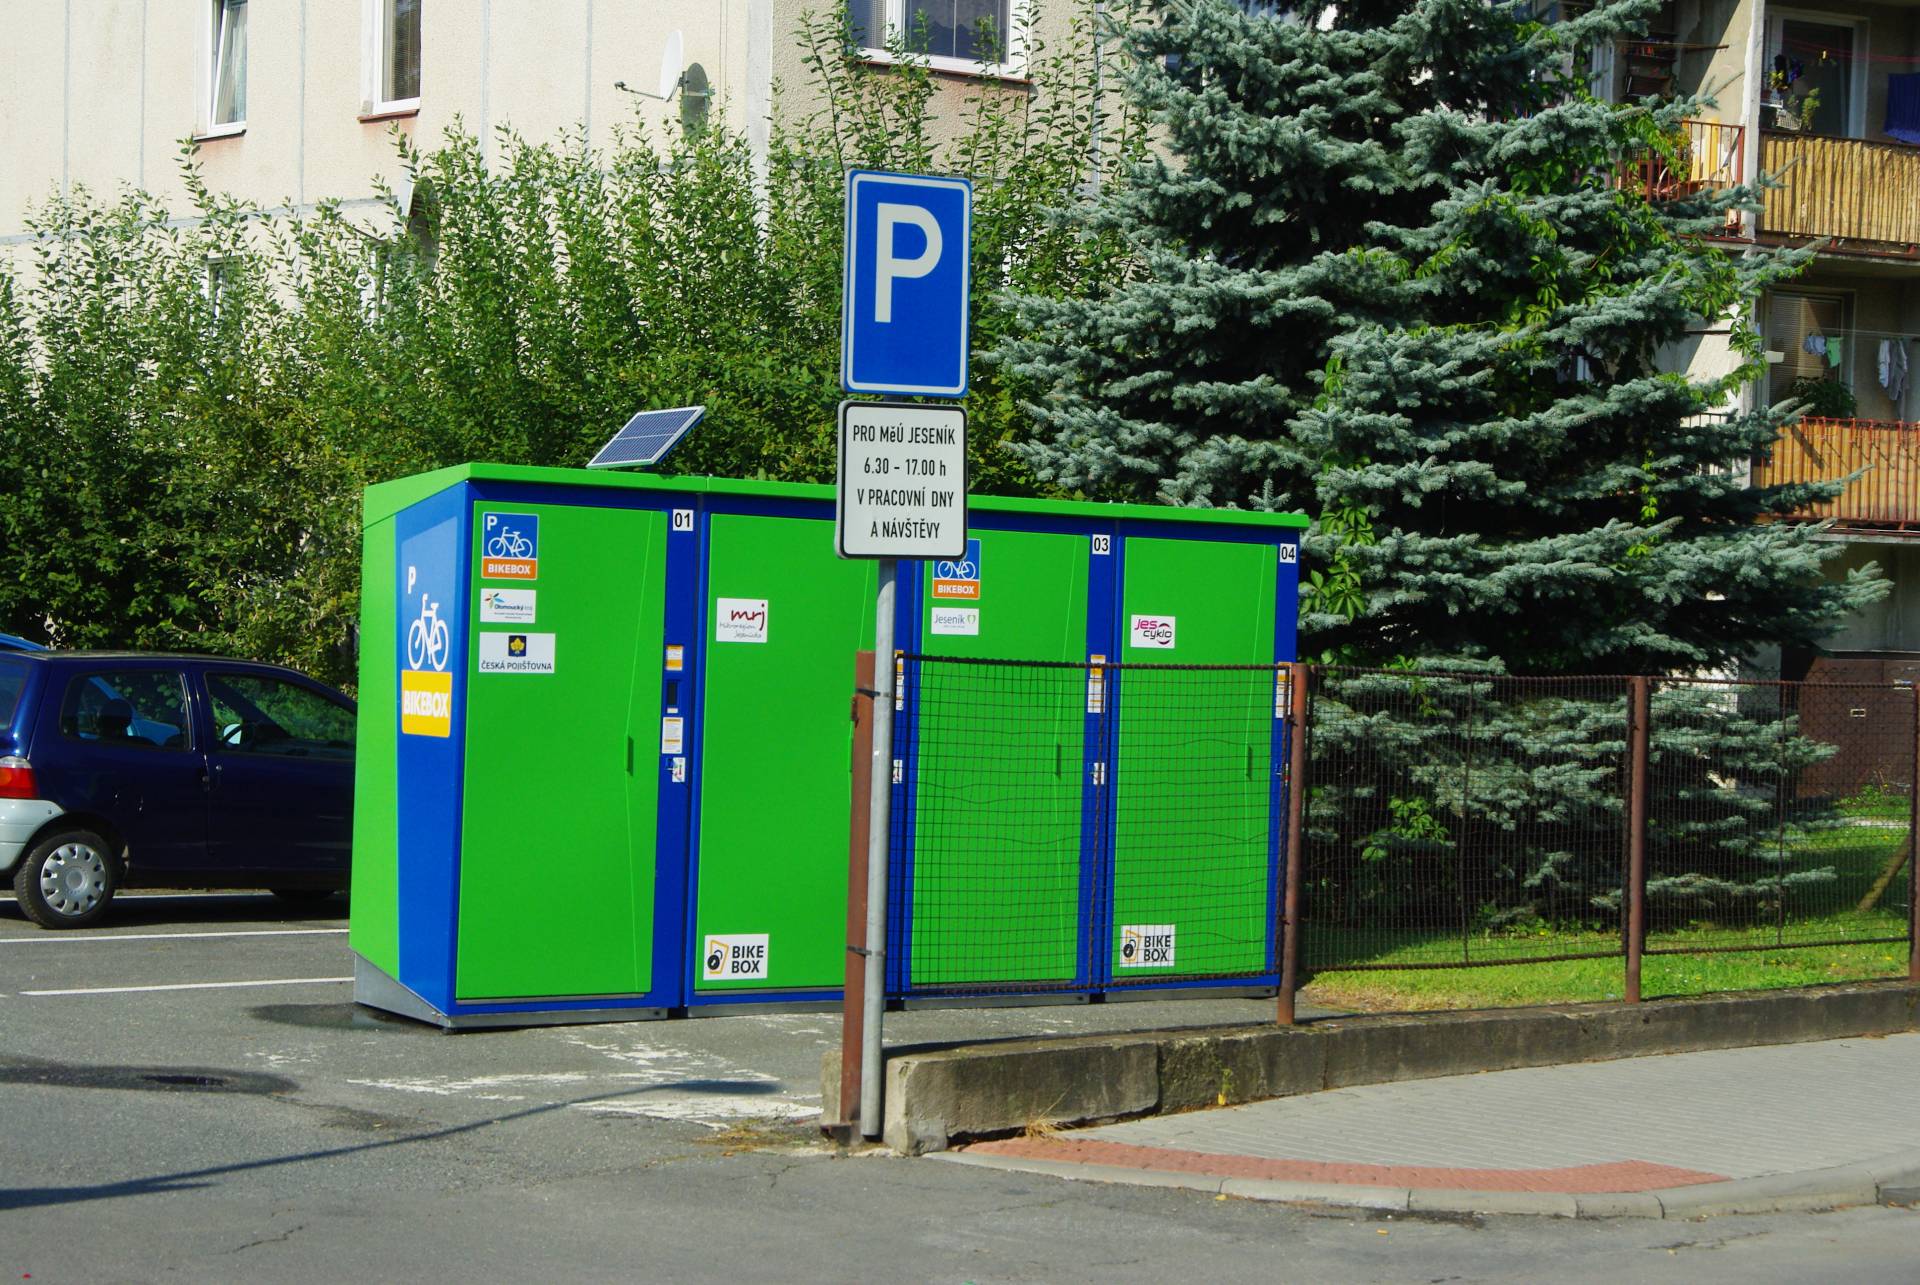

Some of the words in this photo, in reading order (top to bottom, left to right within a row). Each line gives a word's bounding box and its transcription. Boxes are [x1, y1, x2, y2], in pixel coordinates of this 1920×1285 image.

[875, 202, 943, 323] P
[853, 425, 875, 442] PRO
[880, 422, 904, 443] MěÚ
[908, 424, 955, 445] JESENÍK
[864, 457, 889, 474] 6.30
[905, 459, 935, 476] 17.00
[939, 460, 946, 476] h
[857, 488, 864, 505] V
[868, 487, 925, 507] PRACOVNÍ
[931, 491, 954, 507] DNY
[487, 515, 498, 531] P
[674, 512, 690, 528] 01
[870, 521, 878, 537] A
[882, 517, 940, 539] NÁVŠTĚVY
[1093, 537, 1109, 552] 03
[1281, 547, 1295, 560] 04
[487, 563, 531, 575] BIKEBOX
[407, 566, 416, 594] P
[937, 584, 975, 594] BIKEBOX
[731, 603, 765, 631] mrj
[1143, 630, 1172, 639] cyklo
[481, 660, 505, 670] ČESKÁ
[506, 661, 552, 671] POJIŠŤOVNA
[403, 690, 449, 718] BIKEBOX
[1144, 935, 1171, 948] BIKE
[732, 945, 764, 959] BIKE
[1143, 949, 1168, 962] BOX
[731, 960, 760, 973] BOX
